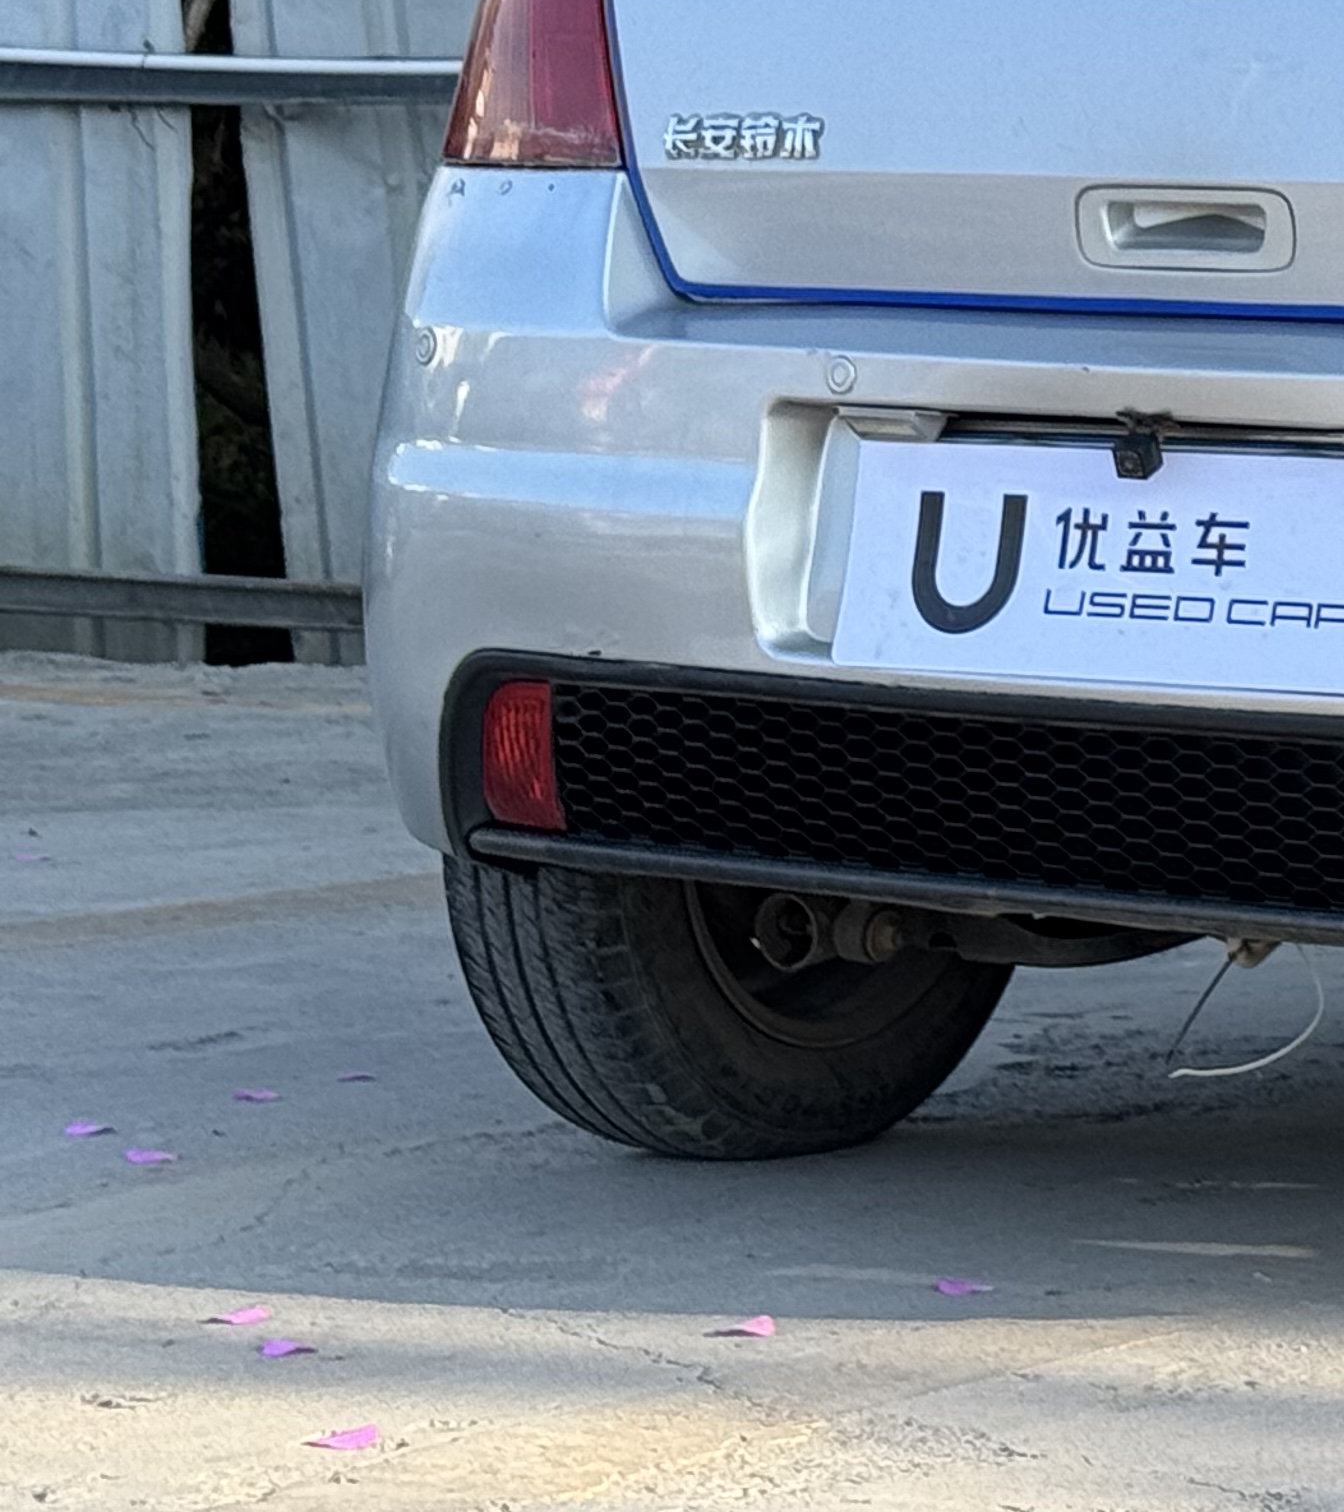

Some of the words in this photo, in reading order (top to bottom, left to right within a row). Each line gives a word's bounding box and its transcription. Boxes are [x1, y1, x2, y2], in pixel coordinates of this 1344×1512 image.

[662, 112, 825, 160] 长安铃木
[911, 490, 1029, 635] U
[1054, 506, 1250, 577] 优益车
[1043, 588, 1214, 624] USED
